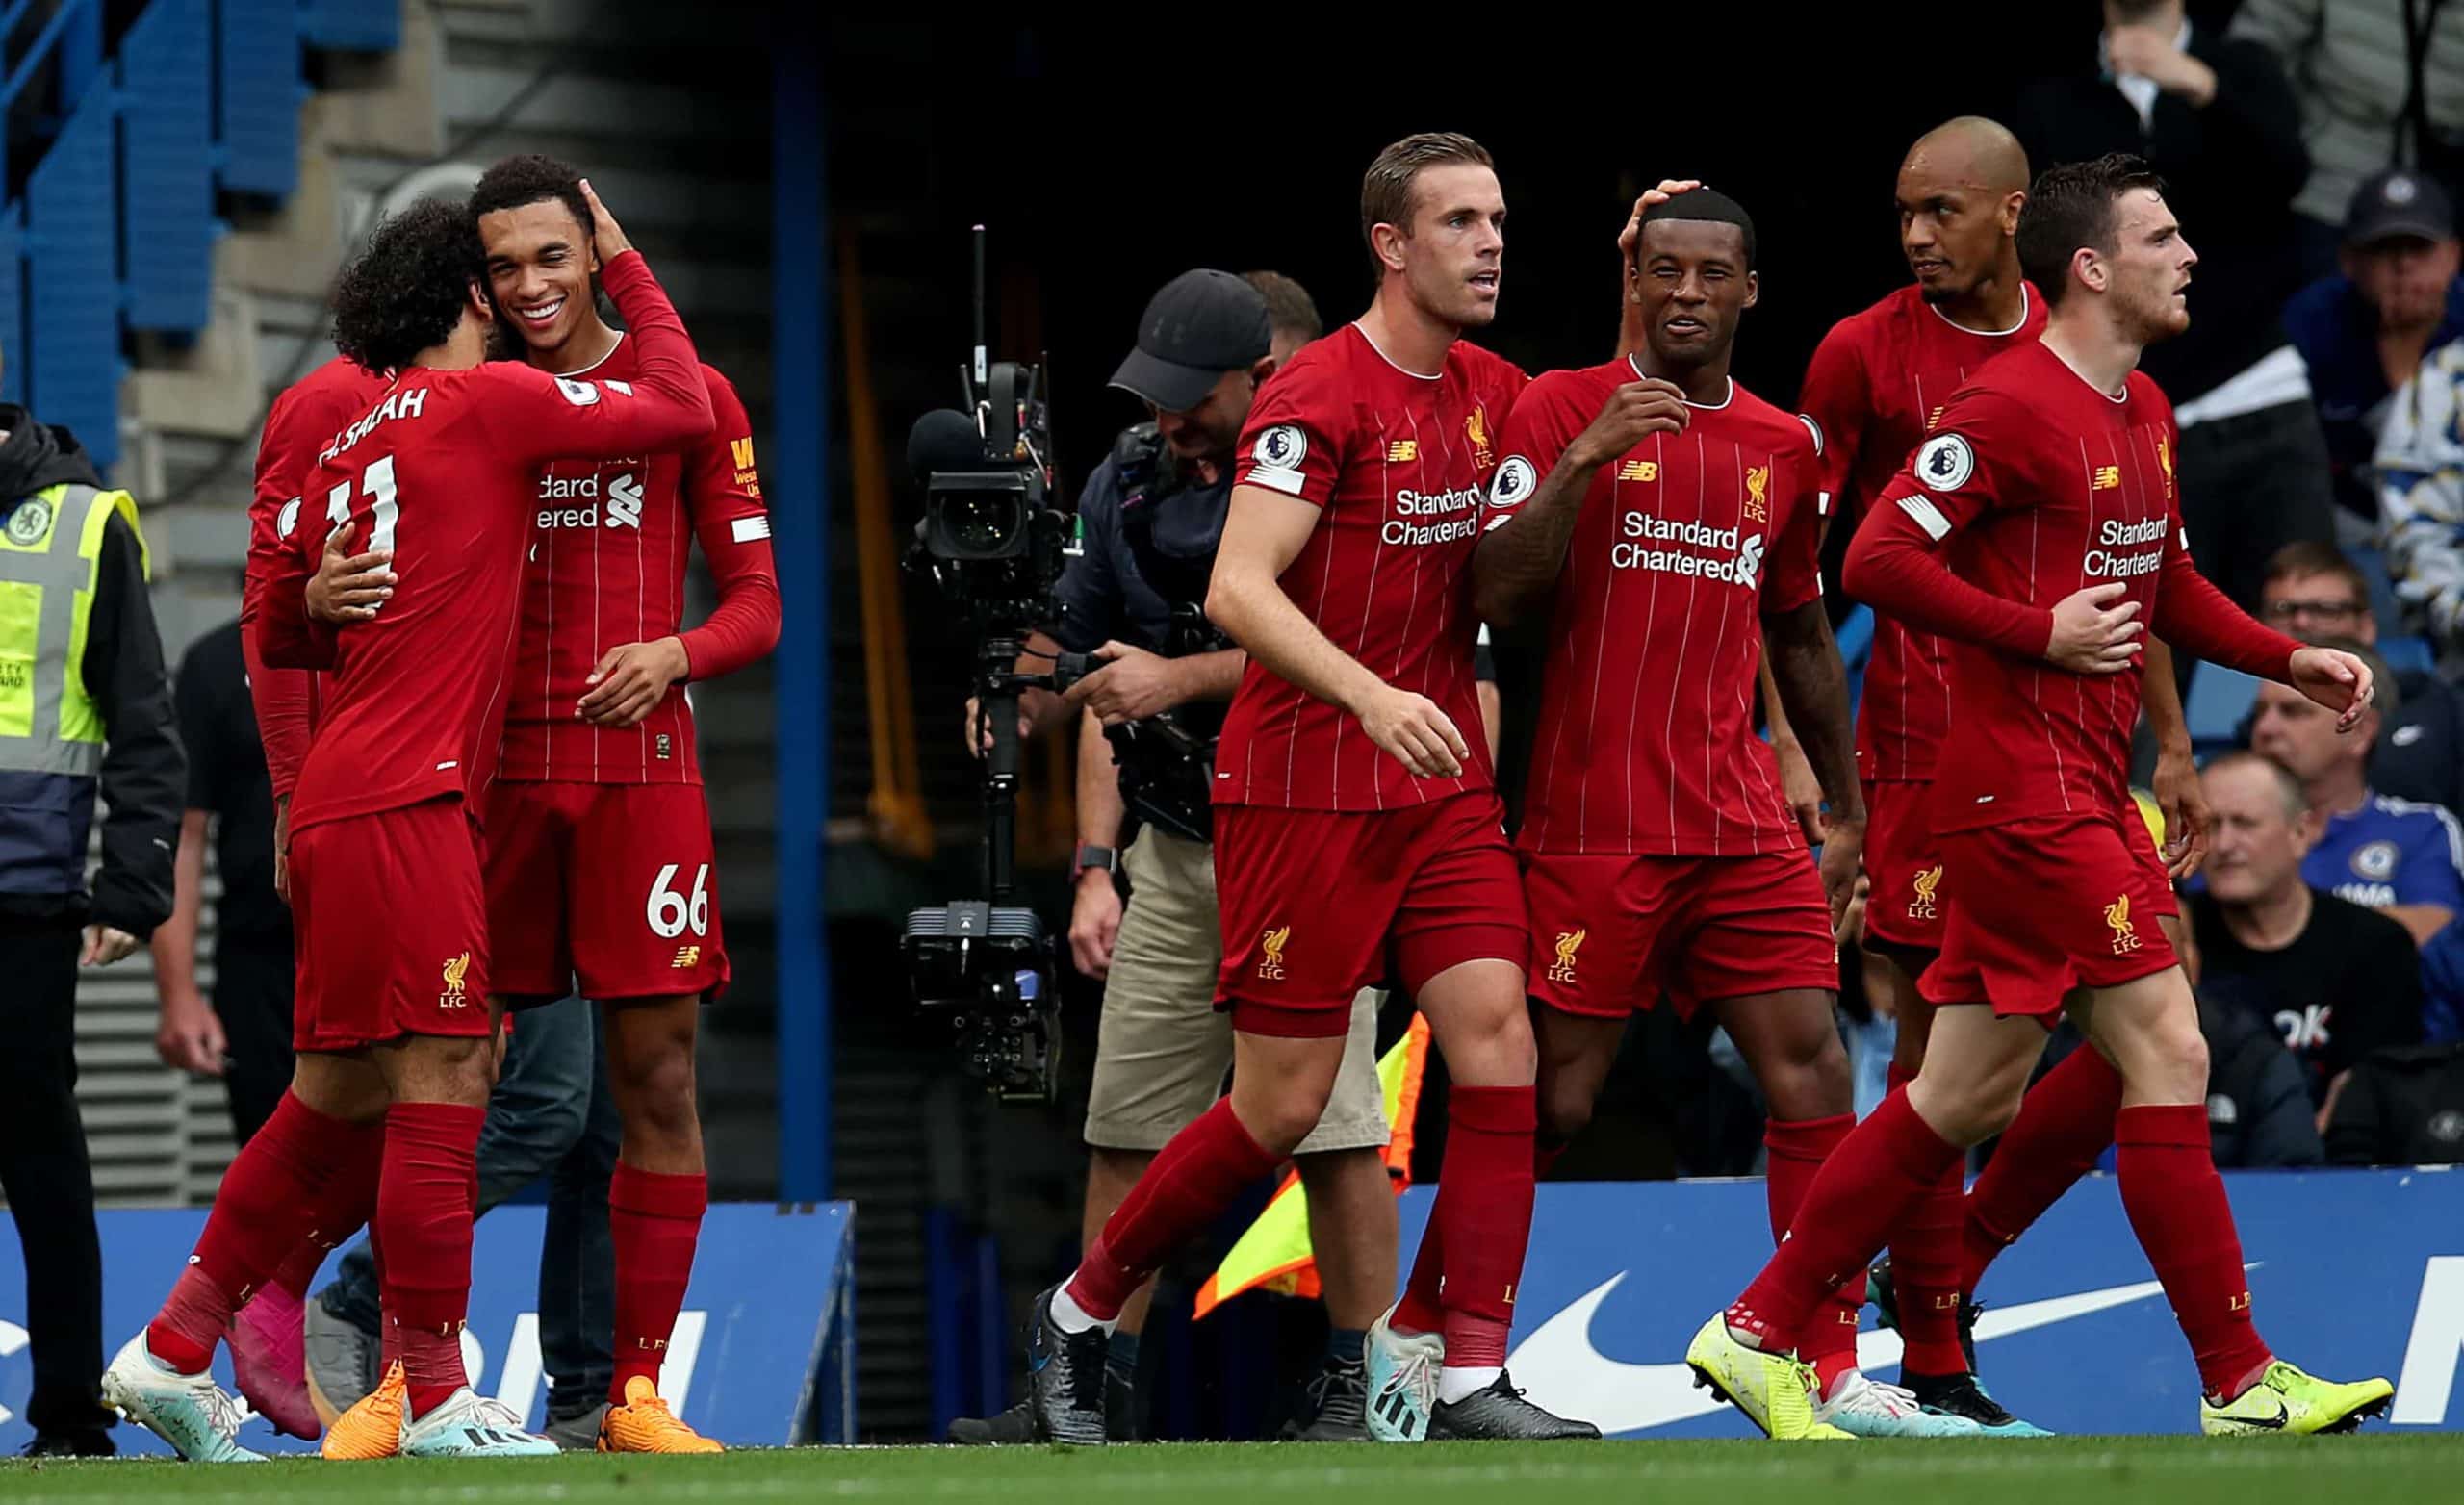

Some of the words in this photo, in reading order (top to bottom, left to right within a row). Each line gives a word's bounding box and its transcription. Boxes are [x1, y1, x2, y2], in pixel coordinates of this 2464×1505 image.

[1396, 482, 1480, 515] Standard
[537, 502, 599, 528] ered
[1743, 505, 1766, 523] LFC
[1381, 511, 1476, 545] Chartered
[1623, 511, 1738, 550] Standard
[2099, 512, 2168, 546] Standard
[1611, 542, 1734, 583] Chartered
[646, 863, 709, 937] 66
[1908, 907, 1938, 919] LFC
[2113, 936, 2143, 955] LFC
[1257, 965, 1287, 981] LFC
[1548, 968, 1577, 983] LFC
[439, 995, 467, 1008] LFC
